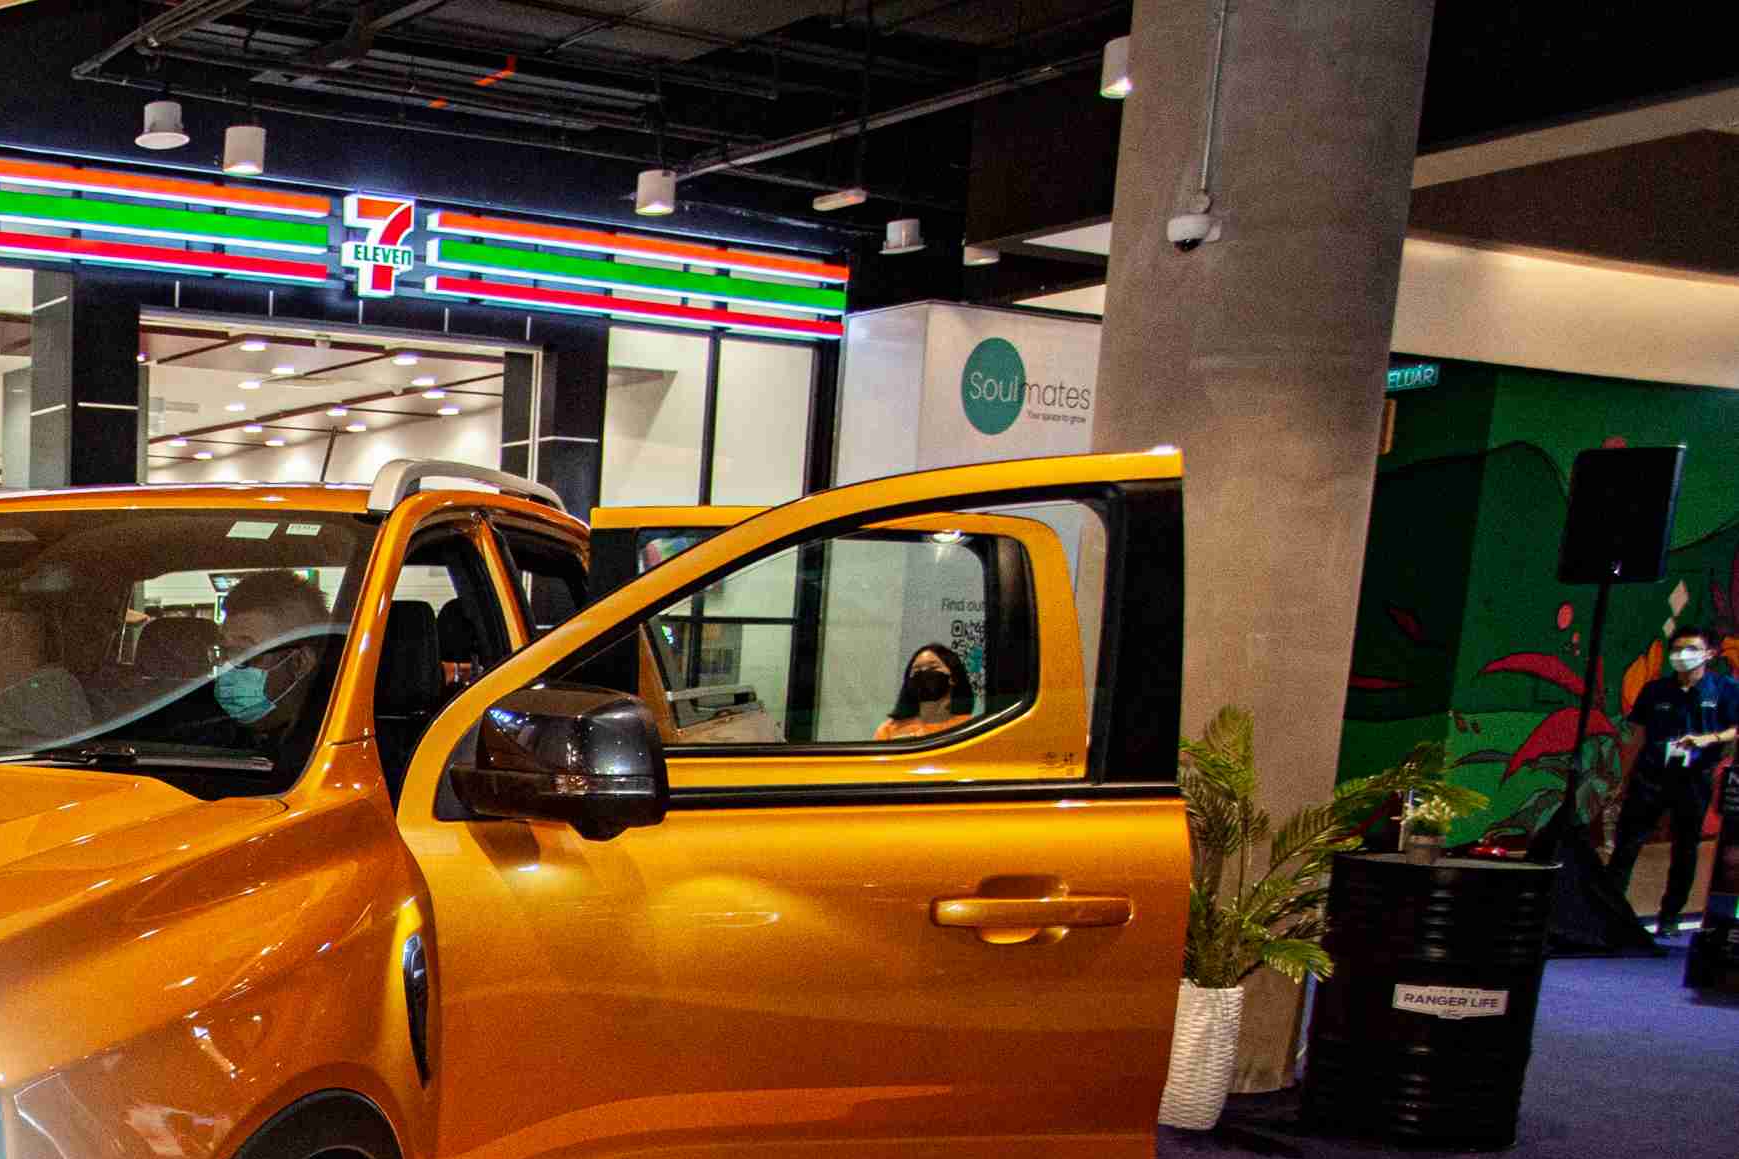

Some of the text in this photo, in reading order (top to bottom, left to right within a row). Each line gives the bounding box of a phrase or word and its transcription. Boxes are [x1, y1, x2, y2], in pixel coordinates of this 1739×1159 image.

[348, 195, 414, 296] 7
[1404, 992, 1499, 1009] RANGER LIFE
